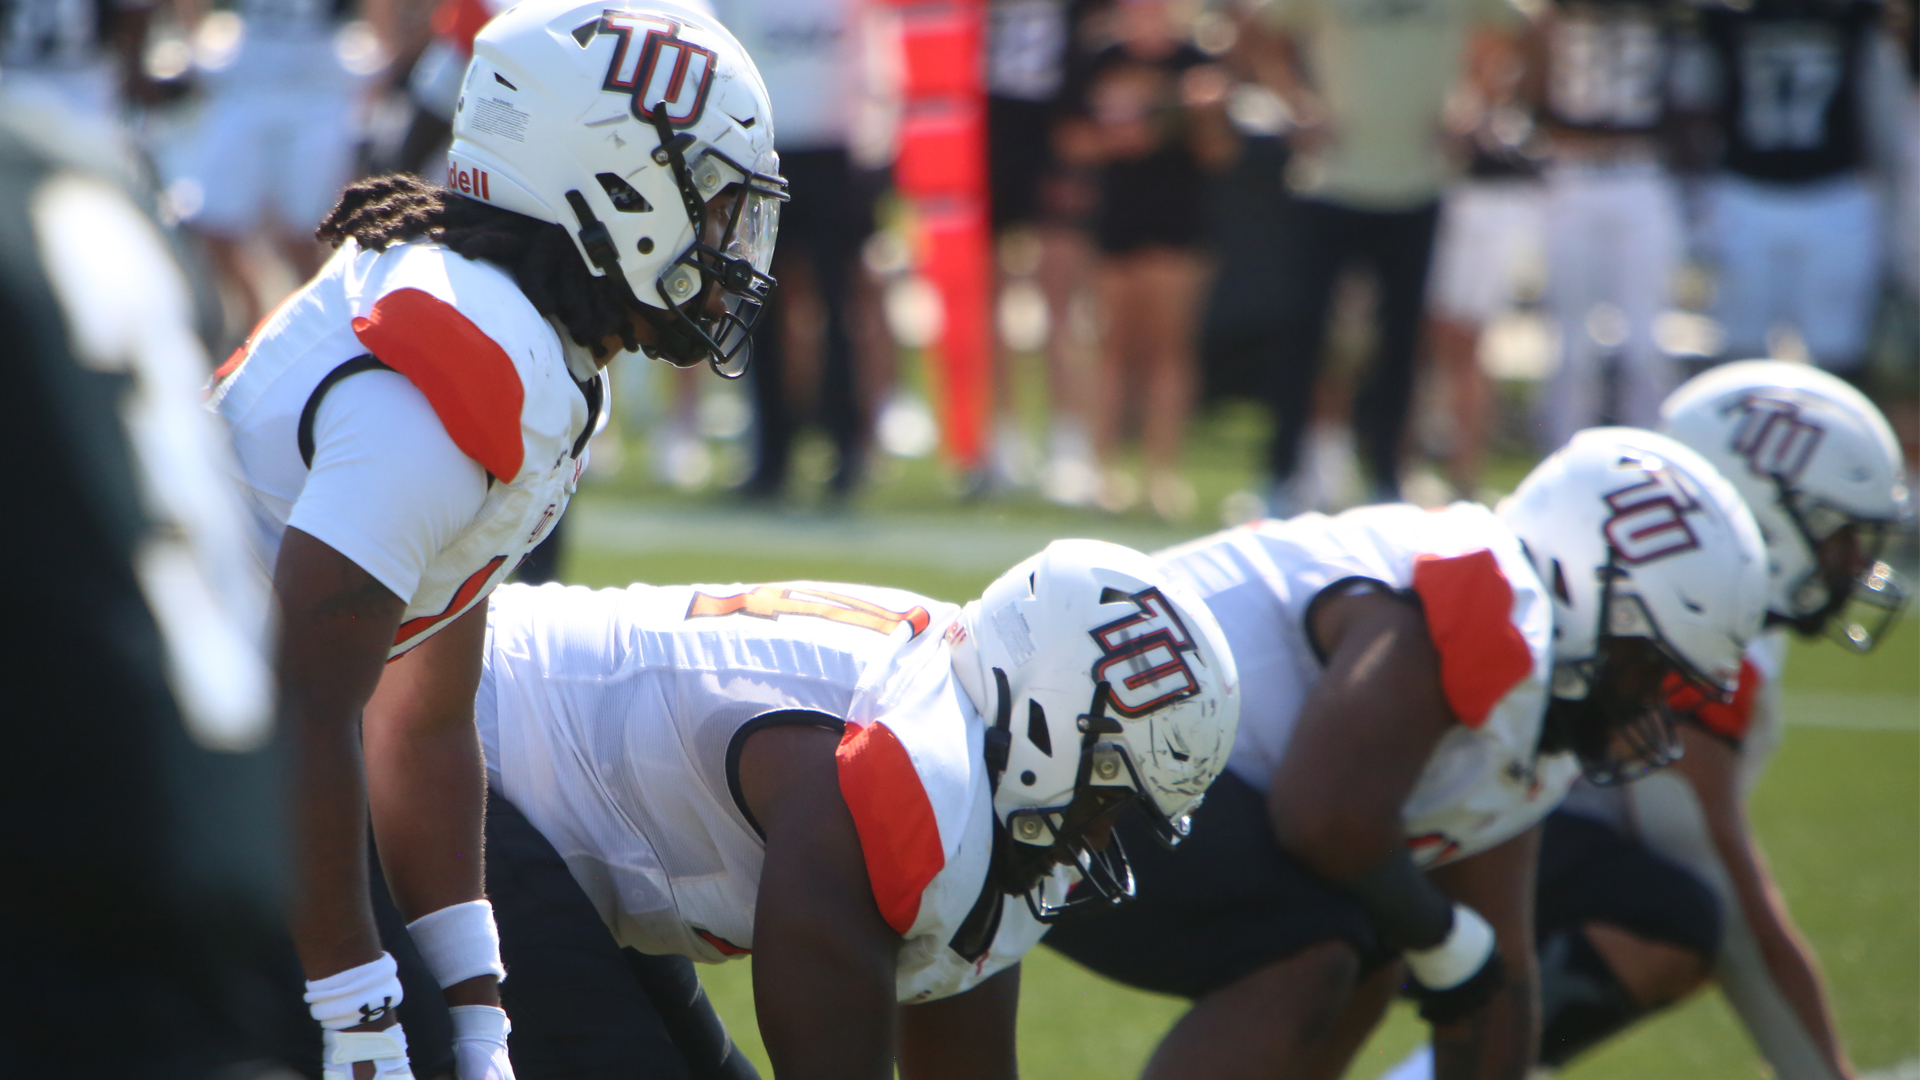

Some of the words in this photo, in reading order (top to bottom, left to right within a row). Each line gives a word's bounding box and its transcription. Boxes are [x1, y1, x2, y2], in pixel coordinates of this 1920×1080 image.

[602, 9, 718, 130] TU
[447, 161, 491, 201] dell
[1730, 395, 1826, 481] TU
[1601, 466, 1702, 566] TU
[1088, 586, 1199, 719] TU
